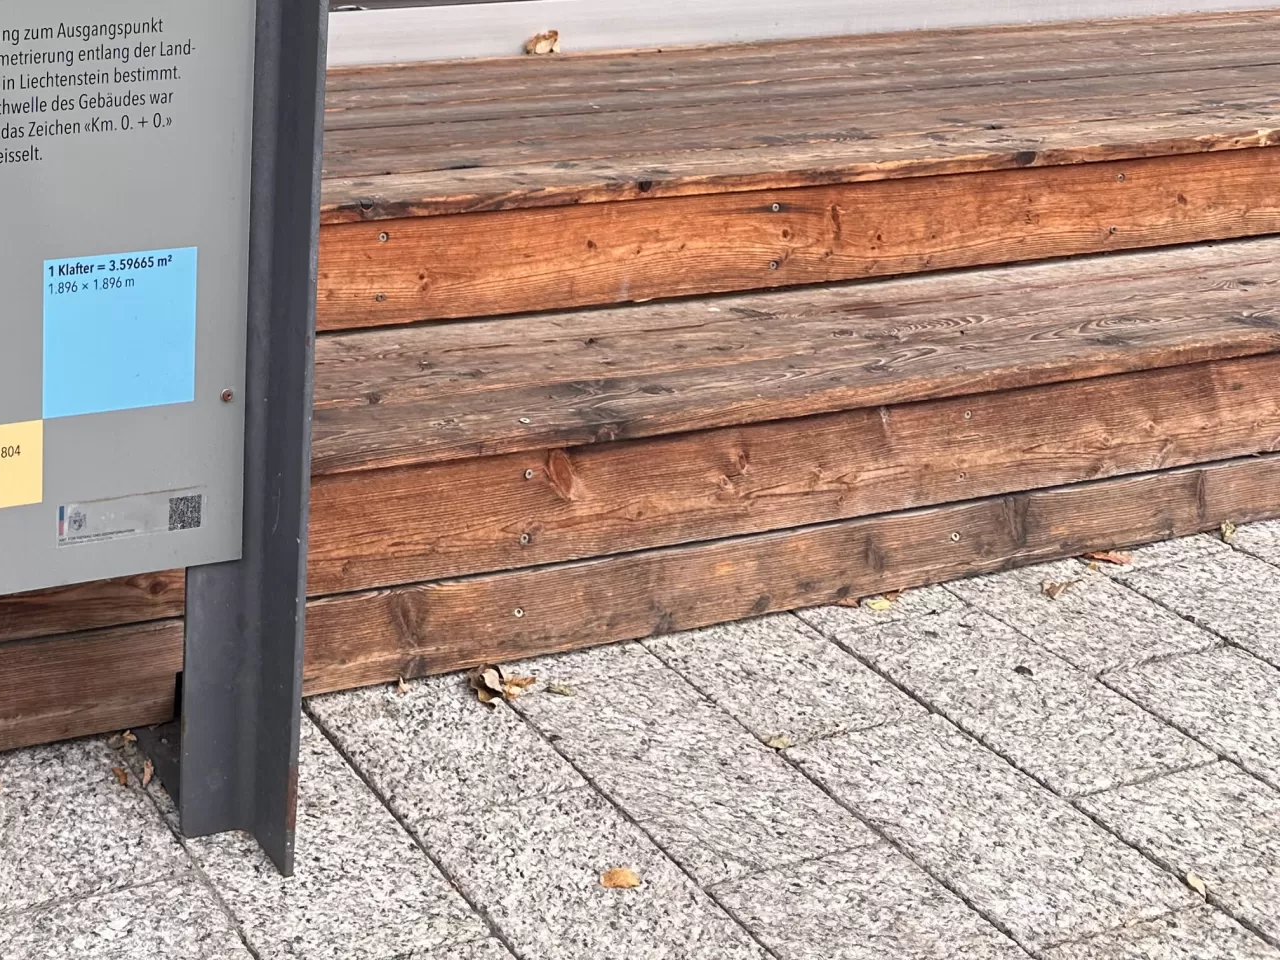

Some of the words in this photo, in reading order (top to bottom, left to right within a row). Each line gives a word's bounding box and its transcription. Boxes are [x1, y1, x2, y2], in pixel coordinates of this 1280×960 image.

[23, 27, 54, 41] zum
[56, 16, 164, 42] Ausgangspunkt
[78, 43, 130, 64] entlang
[133, 41, 157, 58] der
[160, 38, 196, 57] Land-
[2, 75, 15, 91] in
[20, 69, 109, 90] Liechtenstein
[114, 65, 181, 84] bestimmt.
[51, 94, 75, 112] des
[78, 89, 146, 110] Gebäudes
[149, 91, 174, 105] war
[1, 122, 25, 140] das
[28, 119, 81, 138] Zeichen
[121, 114, 134, 131] 0.
[48, 265, 54, 278] 1
[58, 261, 95, 277] Klafter
[108, 255, 155, 272] 3.59665
[48, 280, 79, 295] 1.896
[93, 276, 123, 291] 1.896
[125, 278, 135, 288] m
